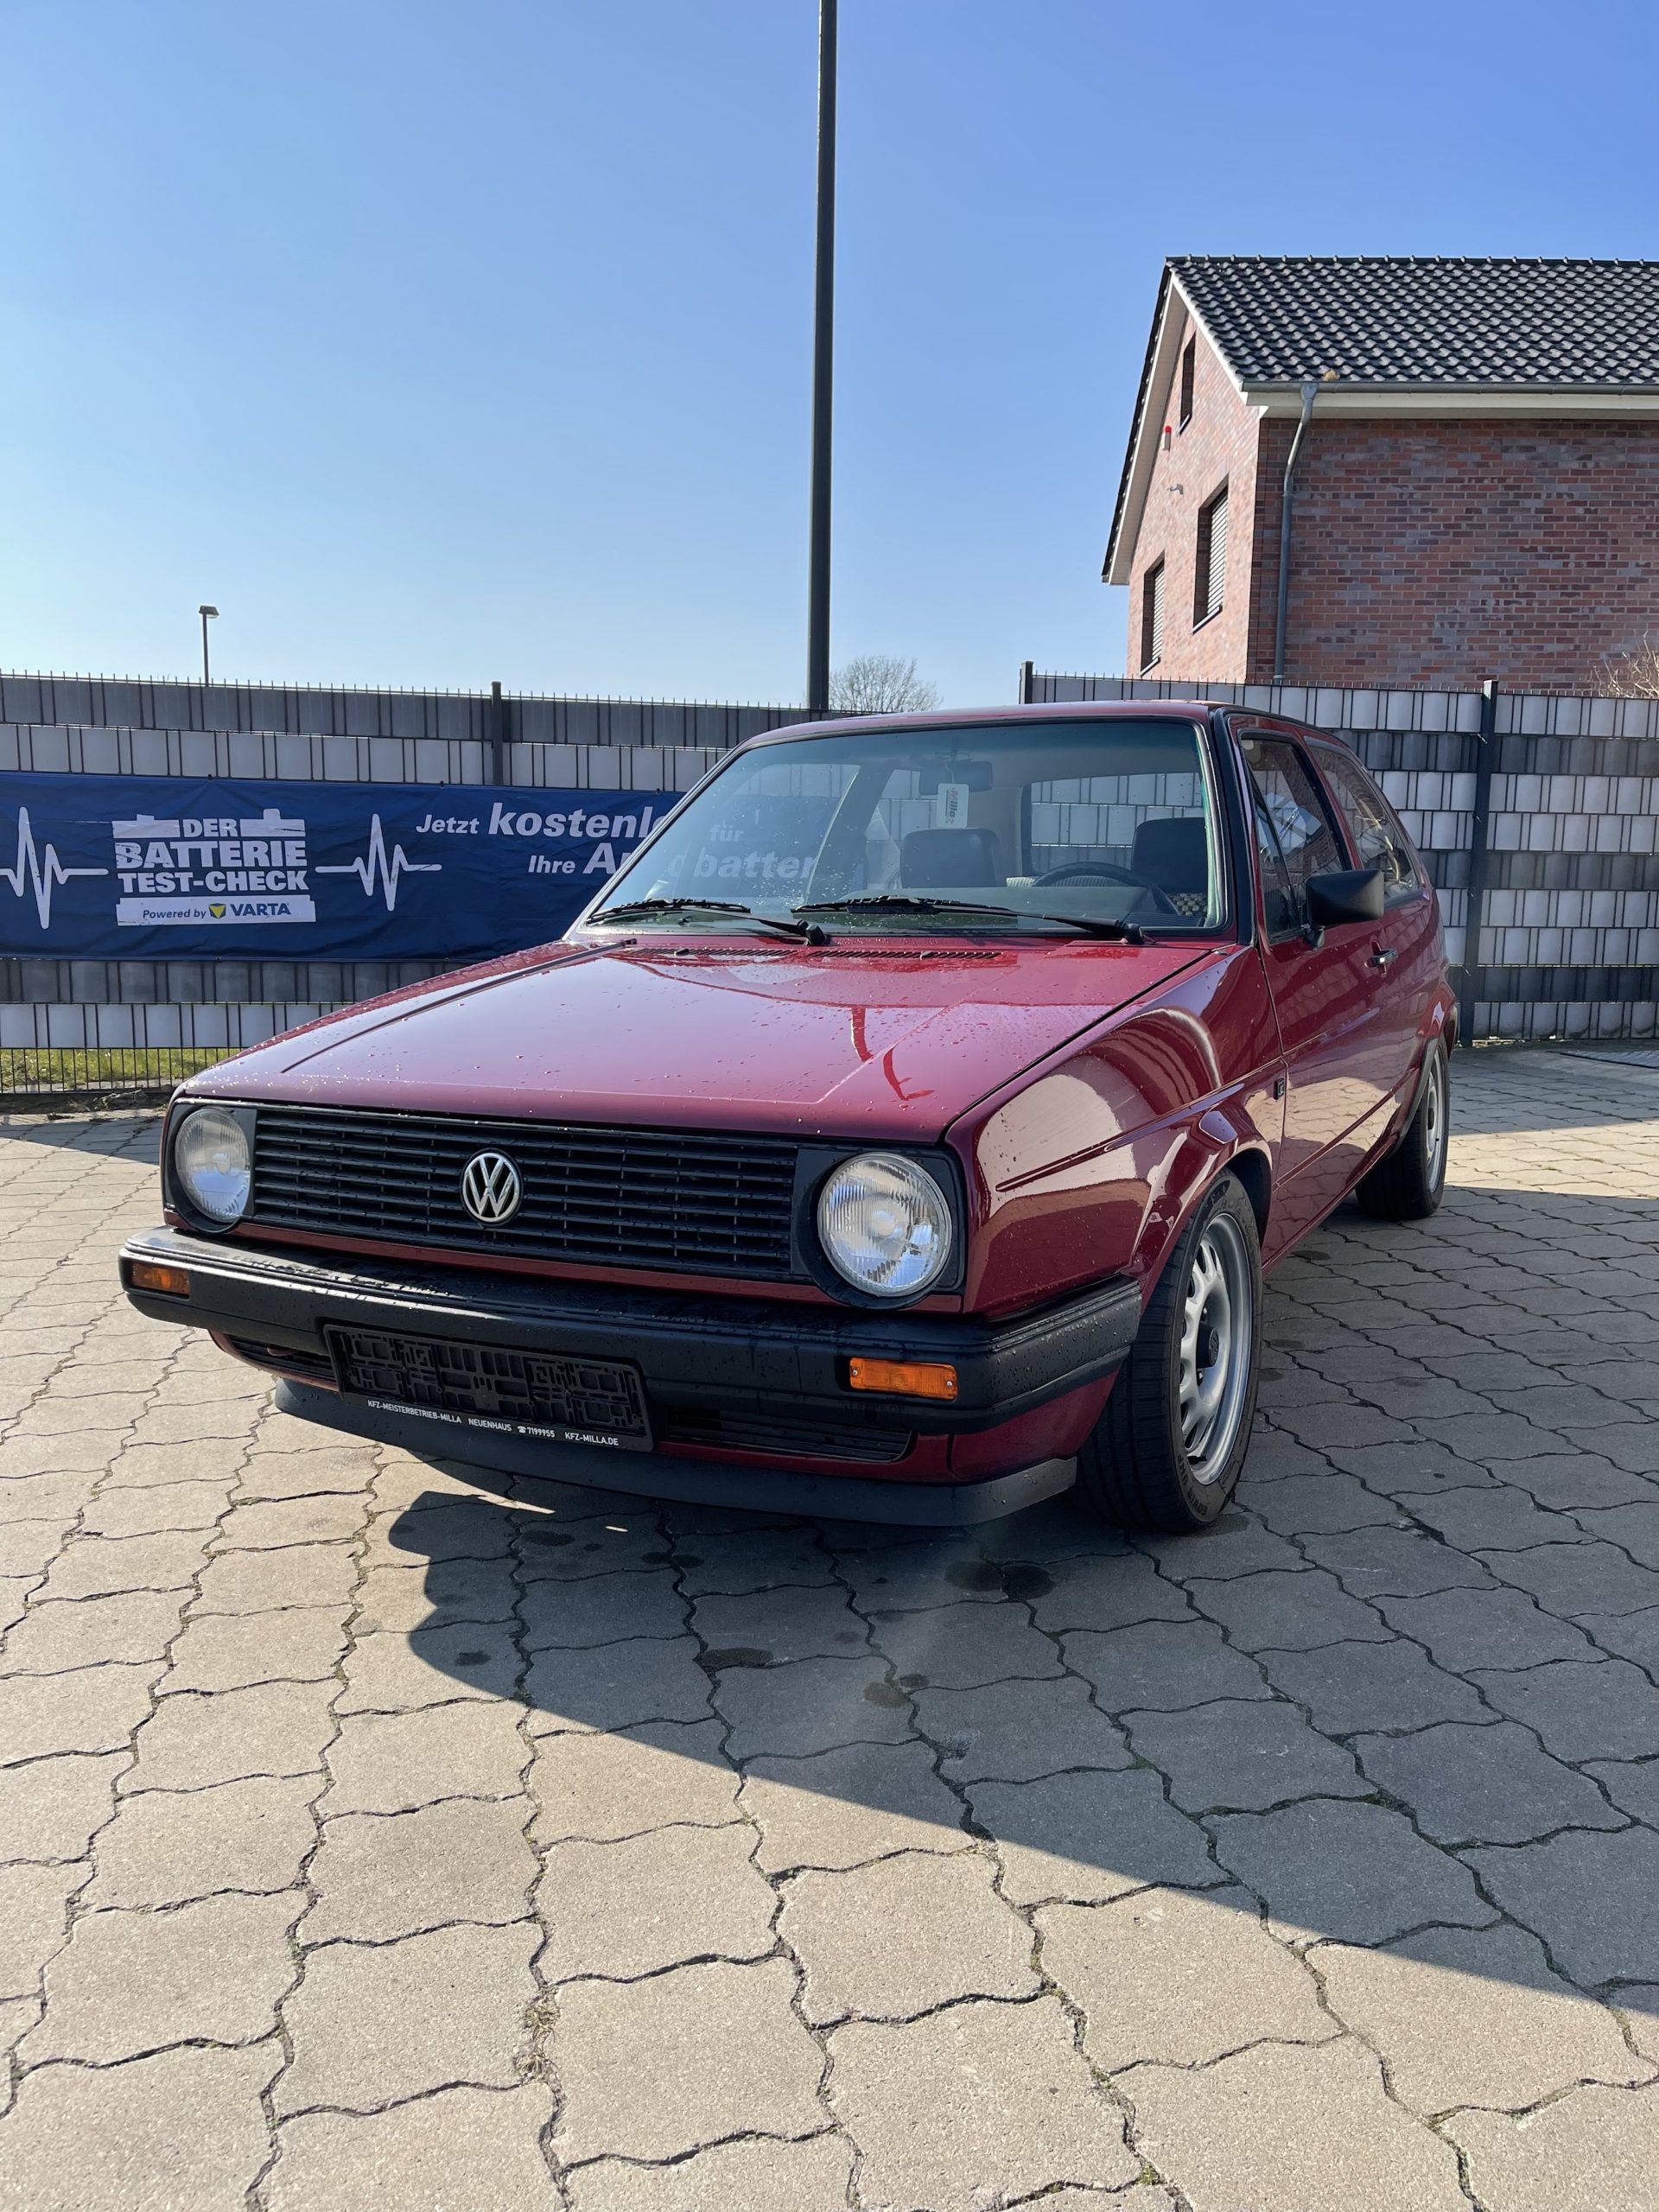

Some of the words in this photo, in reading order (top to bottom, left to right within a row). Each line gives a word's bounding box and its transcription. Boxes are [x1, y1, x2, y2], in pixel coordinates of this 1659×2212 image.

[182, 818, 238, 838] DER
[416, 814, 480, 833] Jetzt
[709, 823, 744, 842] für
[114, 840, 308, 869] BATTERIE
[528, 855, 575, 874] Ihre
[117, 870, 309, 893] TEST-CHECK
[143, 908, 192, 918] Powered
[194, 909, 207, 918] by
[230, 903, 291, 917] VARTA
[462, 1152, 520, 1223] VW
[367, 1399, 462, 1424] KFZ-MEISTERBETRIEB-MILLA
[468, 1417, 512, 1432] NEUENHAUS
[564, 1431, 620, 1446] KFZ-MILLA.DE
